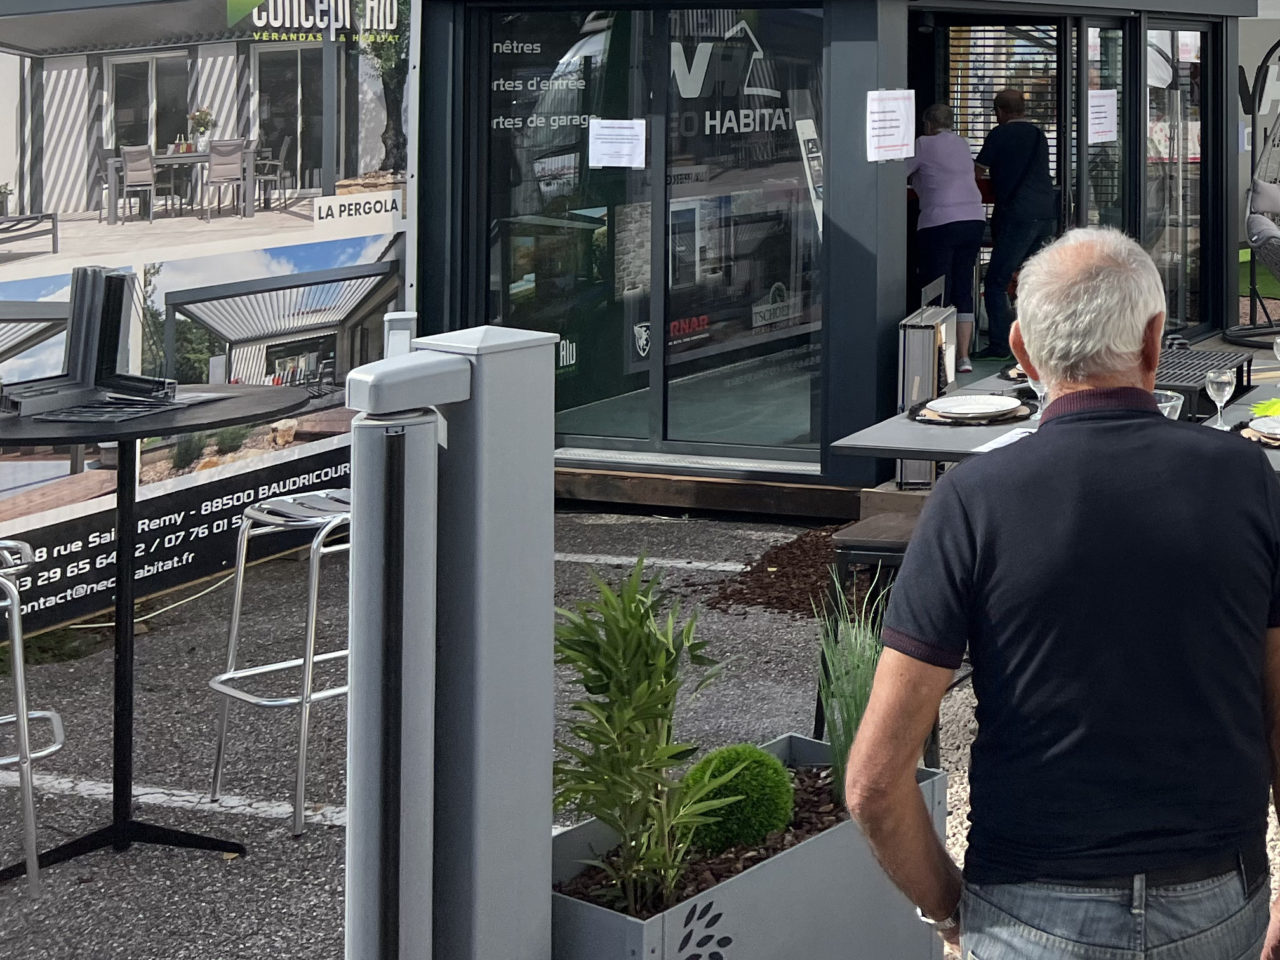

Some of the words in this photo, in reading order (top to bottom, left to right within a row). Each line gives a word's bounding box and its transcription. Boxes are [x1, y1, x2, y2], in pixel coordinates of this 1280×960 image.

[527, 77, 586, 91] d'entrée
[527, 113, 546, 127] de
[704, 107, 794, 135] HABITAT
[317, 204, 337, 220] LA
[338, 197, 400, 217] PERGOLA
[559, 339, 577, 367] Alu
[52, 540, 83, 558] rue
[137, 513, 185, 534] Remy
[200, 489, 255, 516] 88500
[258, 462, 351, 500] BAUDRICOUR
[37, 567, 61, 587] 29
[66, 559, 90, 577] 65
[164, 533, 186, 548] 07
[188, 527, 209, 542] 76
[213, 520, 228, 536] 01
